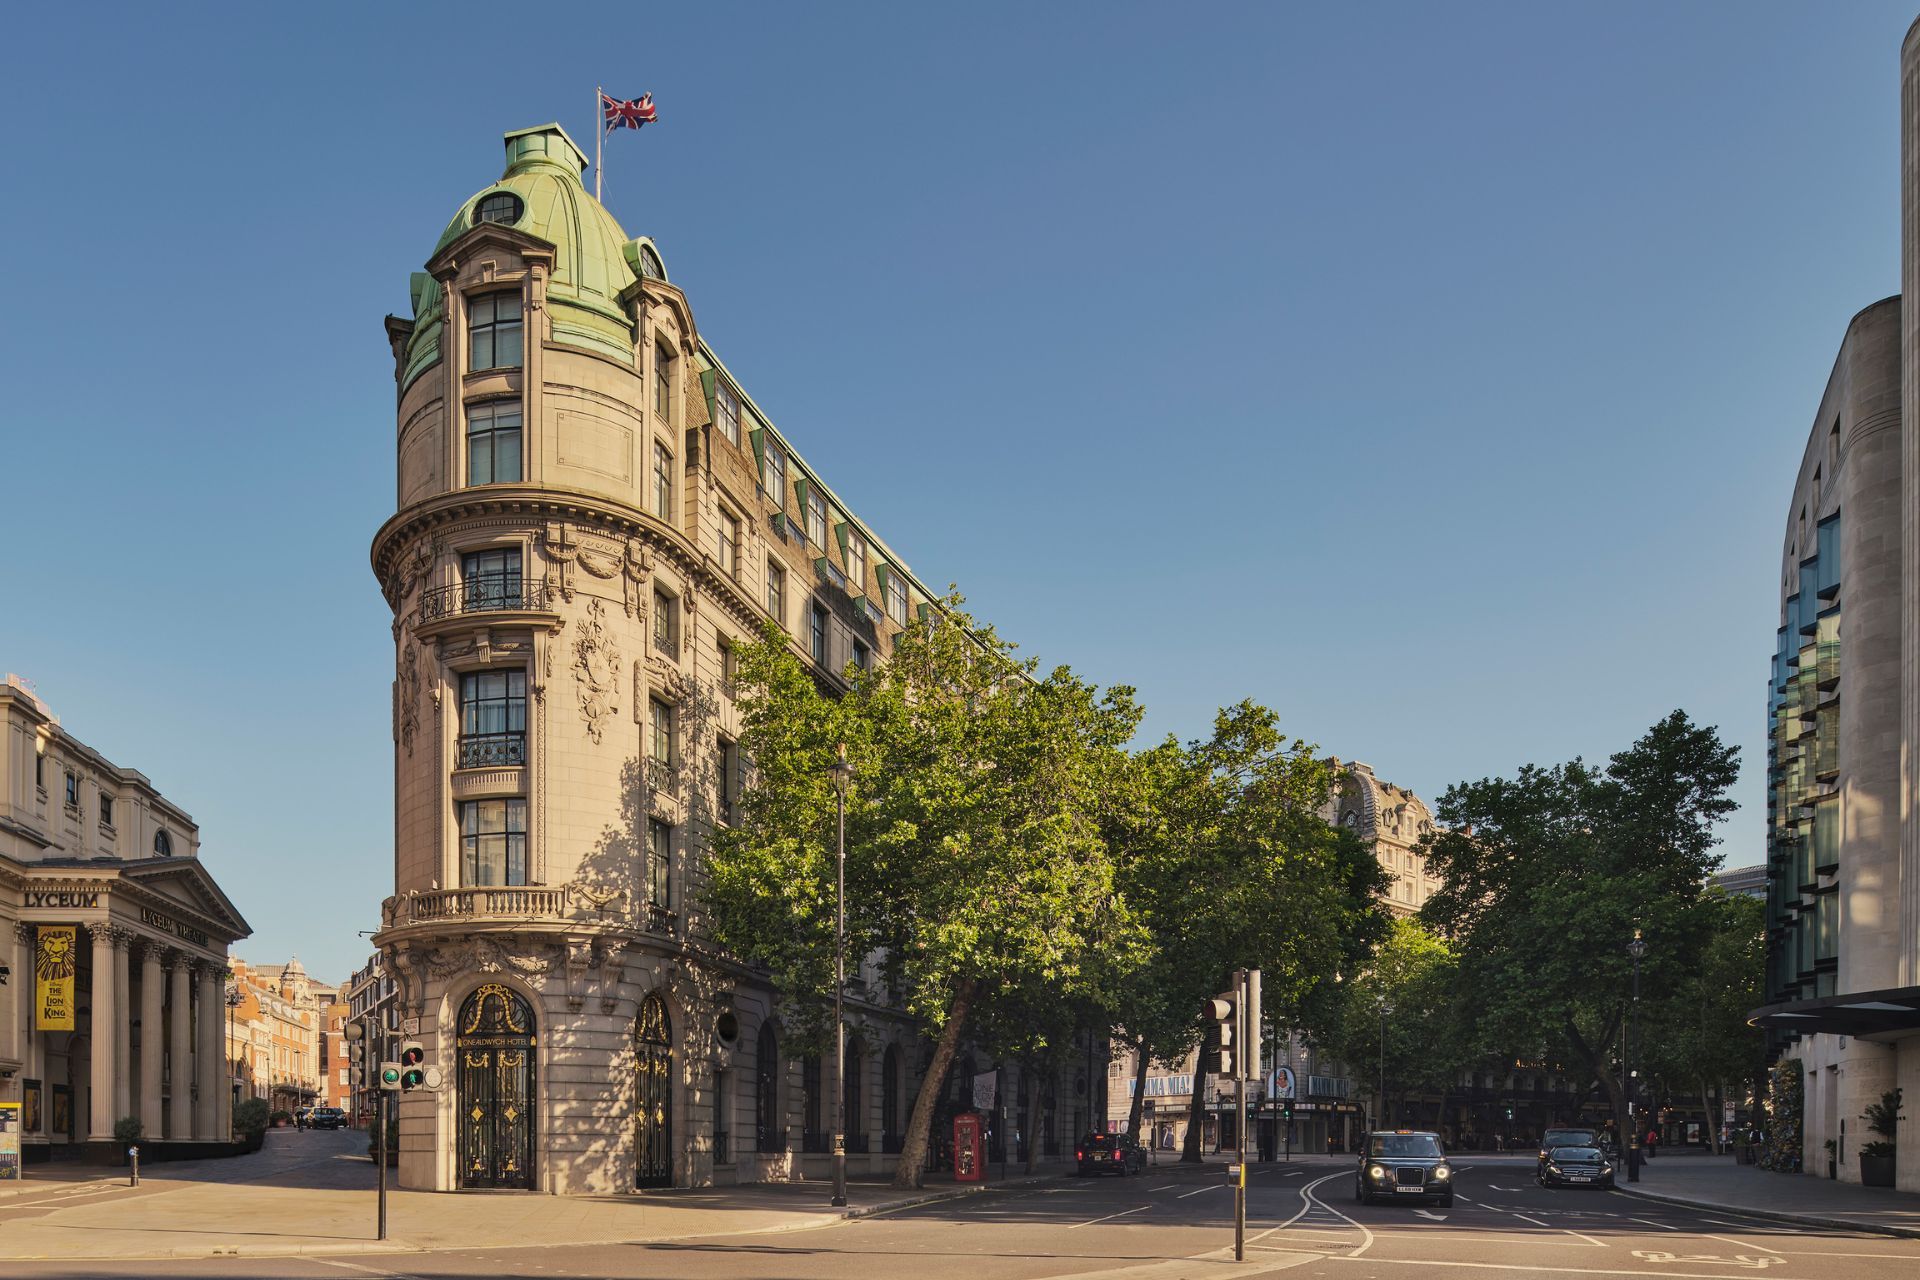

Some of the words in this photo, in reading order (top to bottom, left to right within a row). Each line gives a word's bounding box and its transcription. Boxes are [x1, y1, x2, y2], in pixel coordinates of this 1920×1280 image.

[24, 893, 99, 908] LYCEUM
[142, 907, 173, 932] LYCEUM
[46, 995, 64, 1007] LION
[44, 1007, 66, 1019] KING
